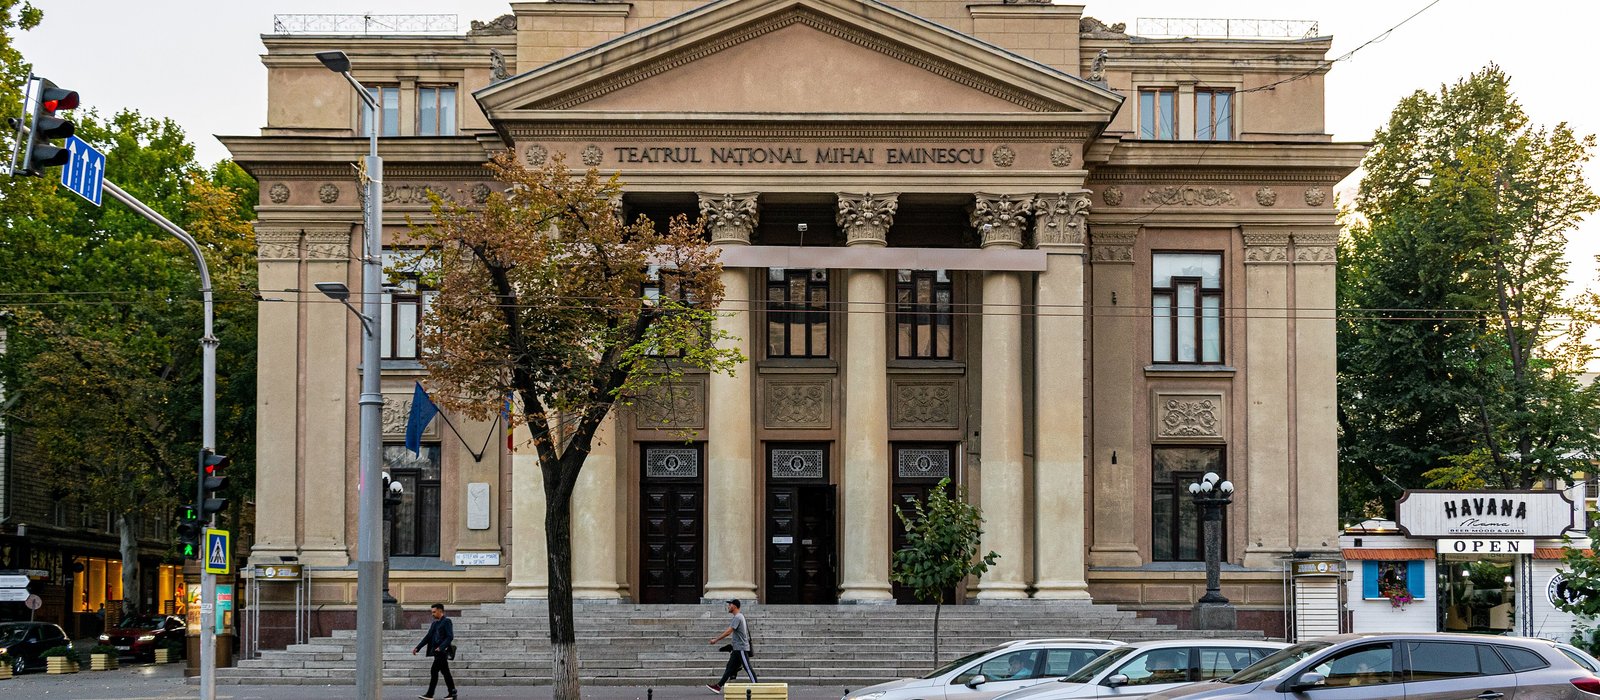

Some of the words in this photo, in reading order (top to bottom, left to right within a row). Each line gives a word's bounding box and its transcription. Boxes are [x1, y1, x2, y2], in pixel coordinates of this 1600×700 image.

[614, 147, 702, 164] TEATRUL
[815, 147, 874, 164] MIHAI
[886, 148, 985, 165] EMINESCU
[1444, 498, 1526, 519] HAVANA
[1453, 540, 1521, 553] OPEN
